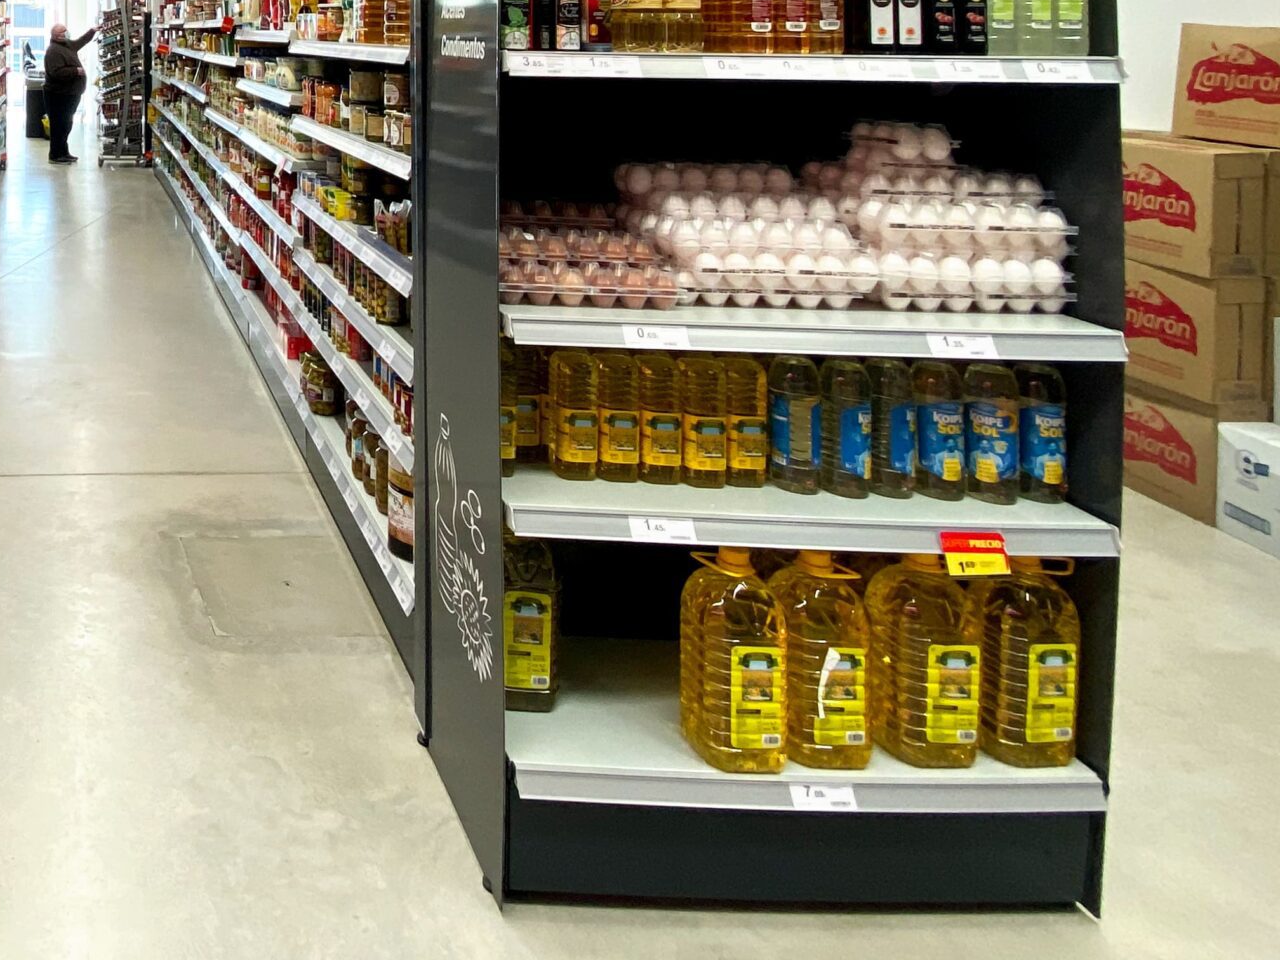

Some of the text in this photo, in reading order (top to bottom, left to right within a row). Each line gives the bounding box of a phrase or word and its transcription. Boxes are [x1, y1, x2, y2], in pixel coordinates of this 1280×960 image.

[441, 34, 485, 59] Condimentos
[1125, 192, 1189, 216] njarón
[1125, 308, 1191, 338] njarón
[971, 412, 1003, 428] KOIPE
[973, 423, 1000, 437] SOL
[1124, 427, 1190, 468] njarón
